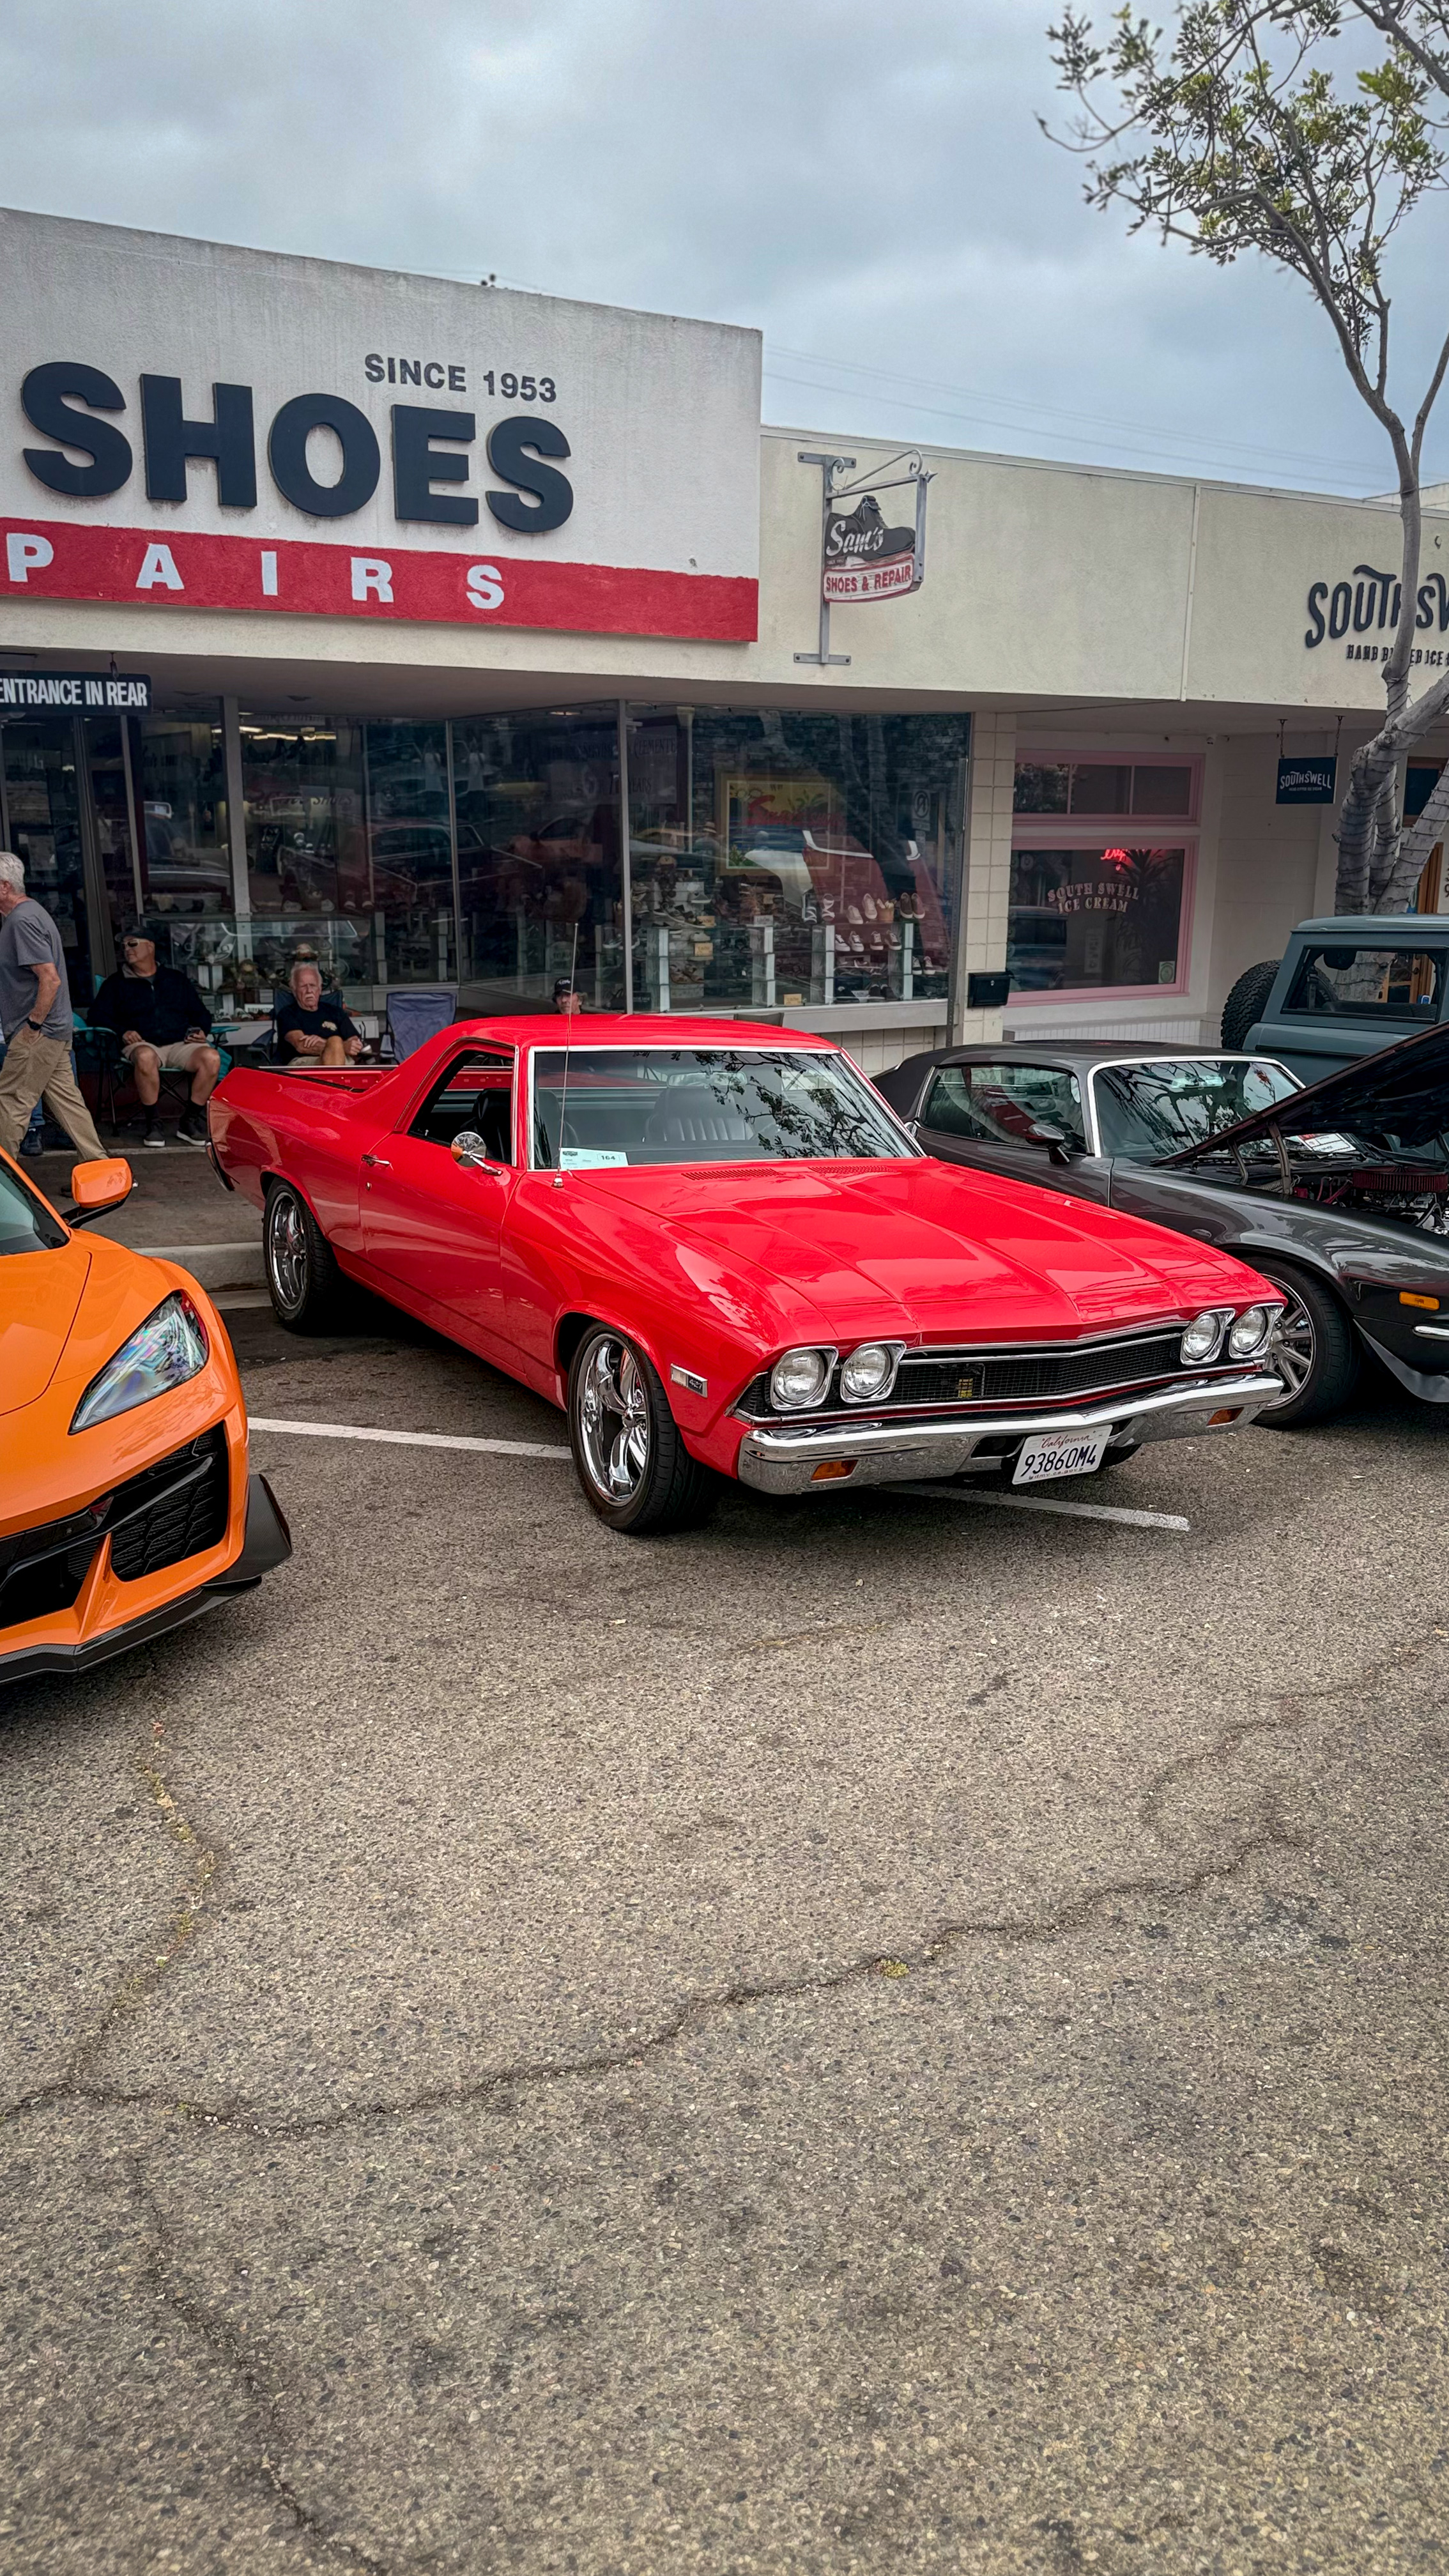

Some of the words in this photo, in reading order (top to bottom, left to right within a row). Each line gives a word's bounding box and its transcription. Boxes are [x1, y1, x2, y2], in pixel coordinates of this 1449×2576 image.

[365, 353, 466, 393] SINCE
[483, 371, 556, 402] 1953
[20, 362, 574, 533] SHOES
[826, 520, 884, 556] Sam's
[6, 533, 505, 610] PAIRS
[826, 576, 858, 592] SHOES
[862, 576, 870, 592] &
[874, 564, 912, 590] REPAIR
[1425, 650, 1444, 666] ICE
[85, 680, 104, 706] IN
[105, 681, 148, 707] REAR
[1280, 770, 1332, 790] SOUTHSWELL
[1047, 882, 1093, 901] SOUTH
[1098, 882, 1139, 900] SWELL
[1058, 898, 1080, 914] ICE
[1085, 897, 1128, 913] CREAM
[1041, 1434, 1094, 1449] California
[1020, 1444, 1098, 1477] 93860M4
